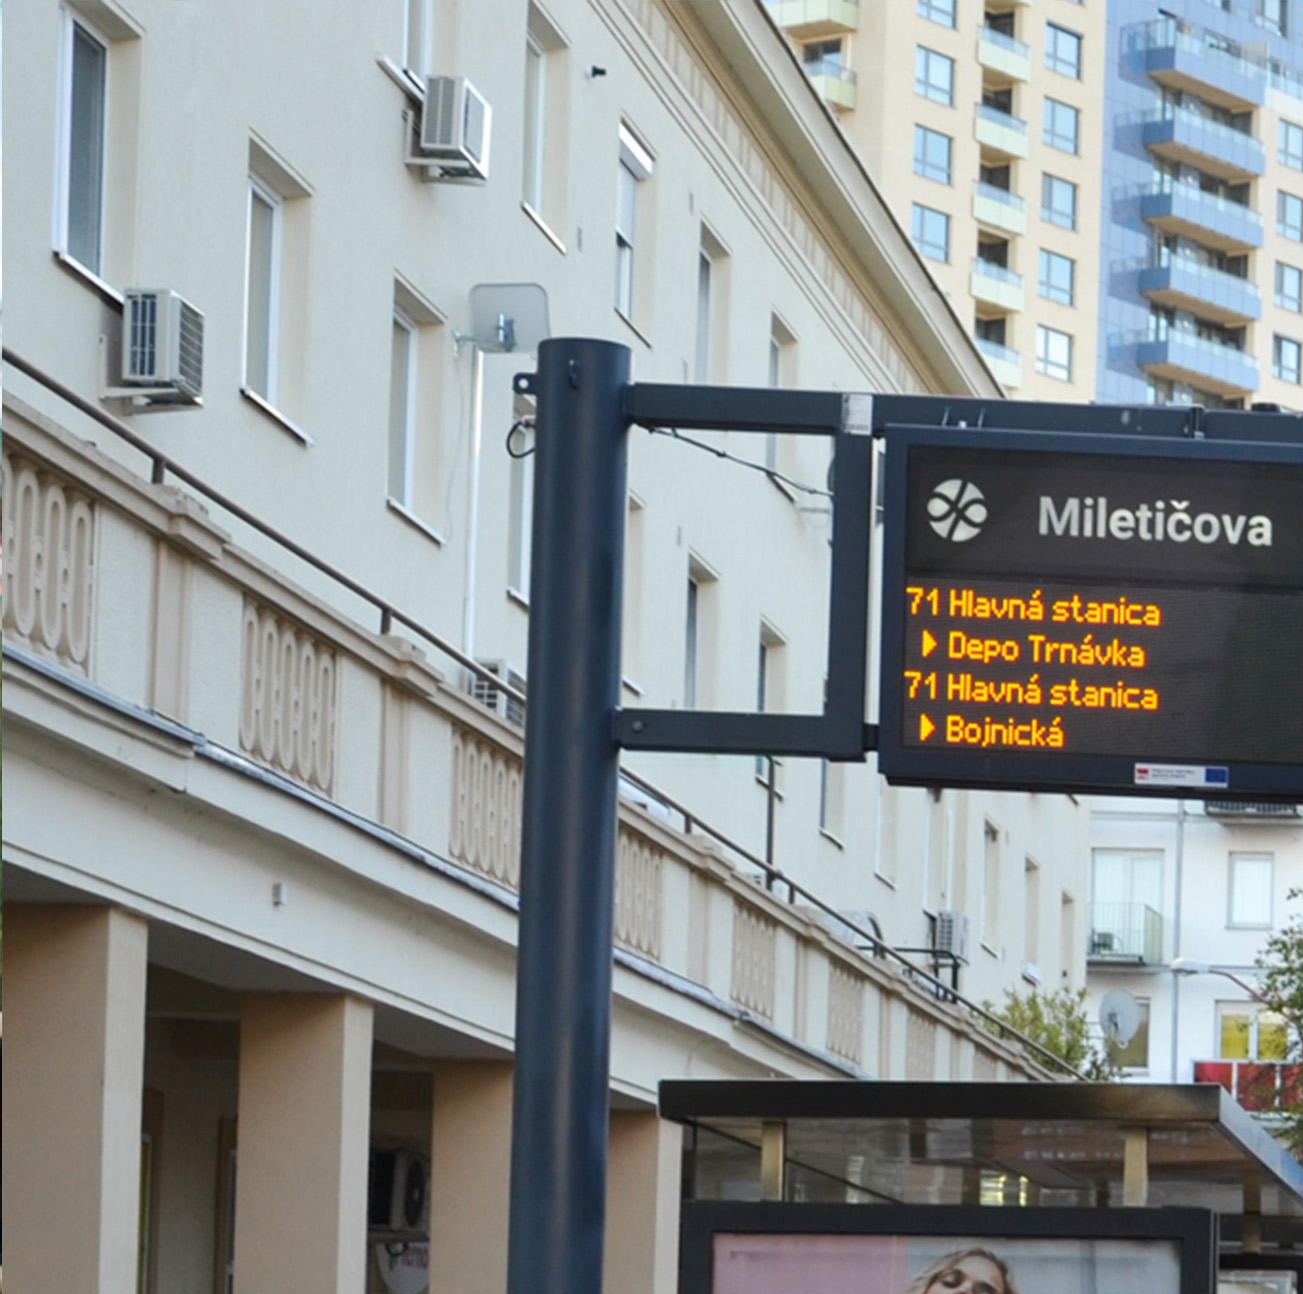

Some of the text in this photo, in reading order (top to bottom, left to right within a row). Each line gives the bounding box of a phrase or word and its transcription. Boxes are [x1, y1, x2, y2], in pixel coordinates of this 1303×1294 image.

[1038, 496, 1273, 546] Miletičova
[907, 588, 1161, 626] 71 Hlavná stanica
[948, 631, 1146, 668] Depo Trnávka
[905, 671, 1159, 710] 71 Hlavná stanica
[946, 715, 1064, 748] Bojnická
